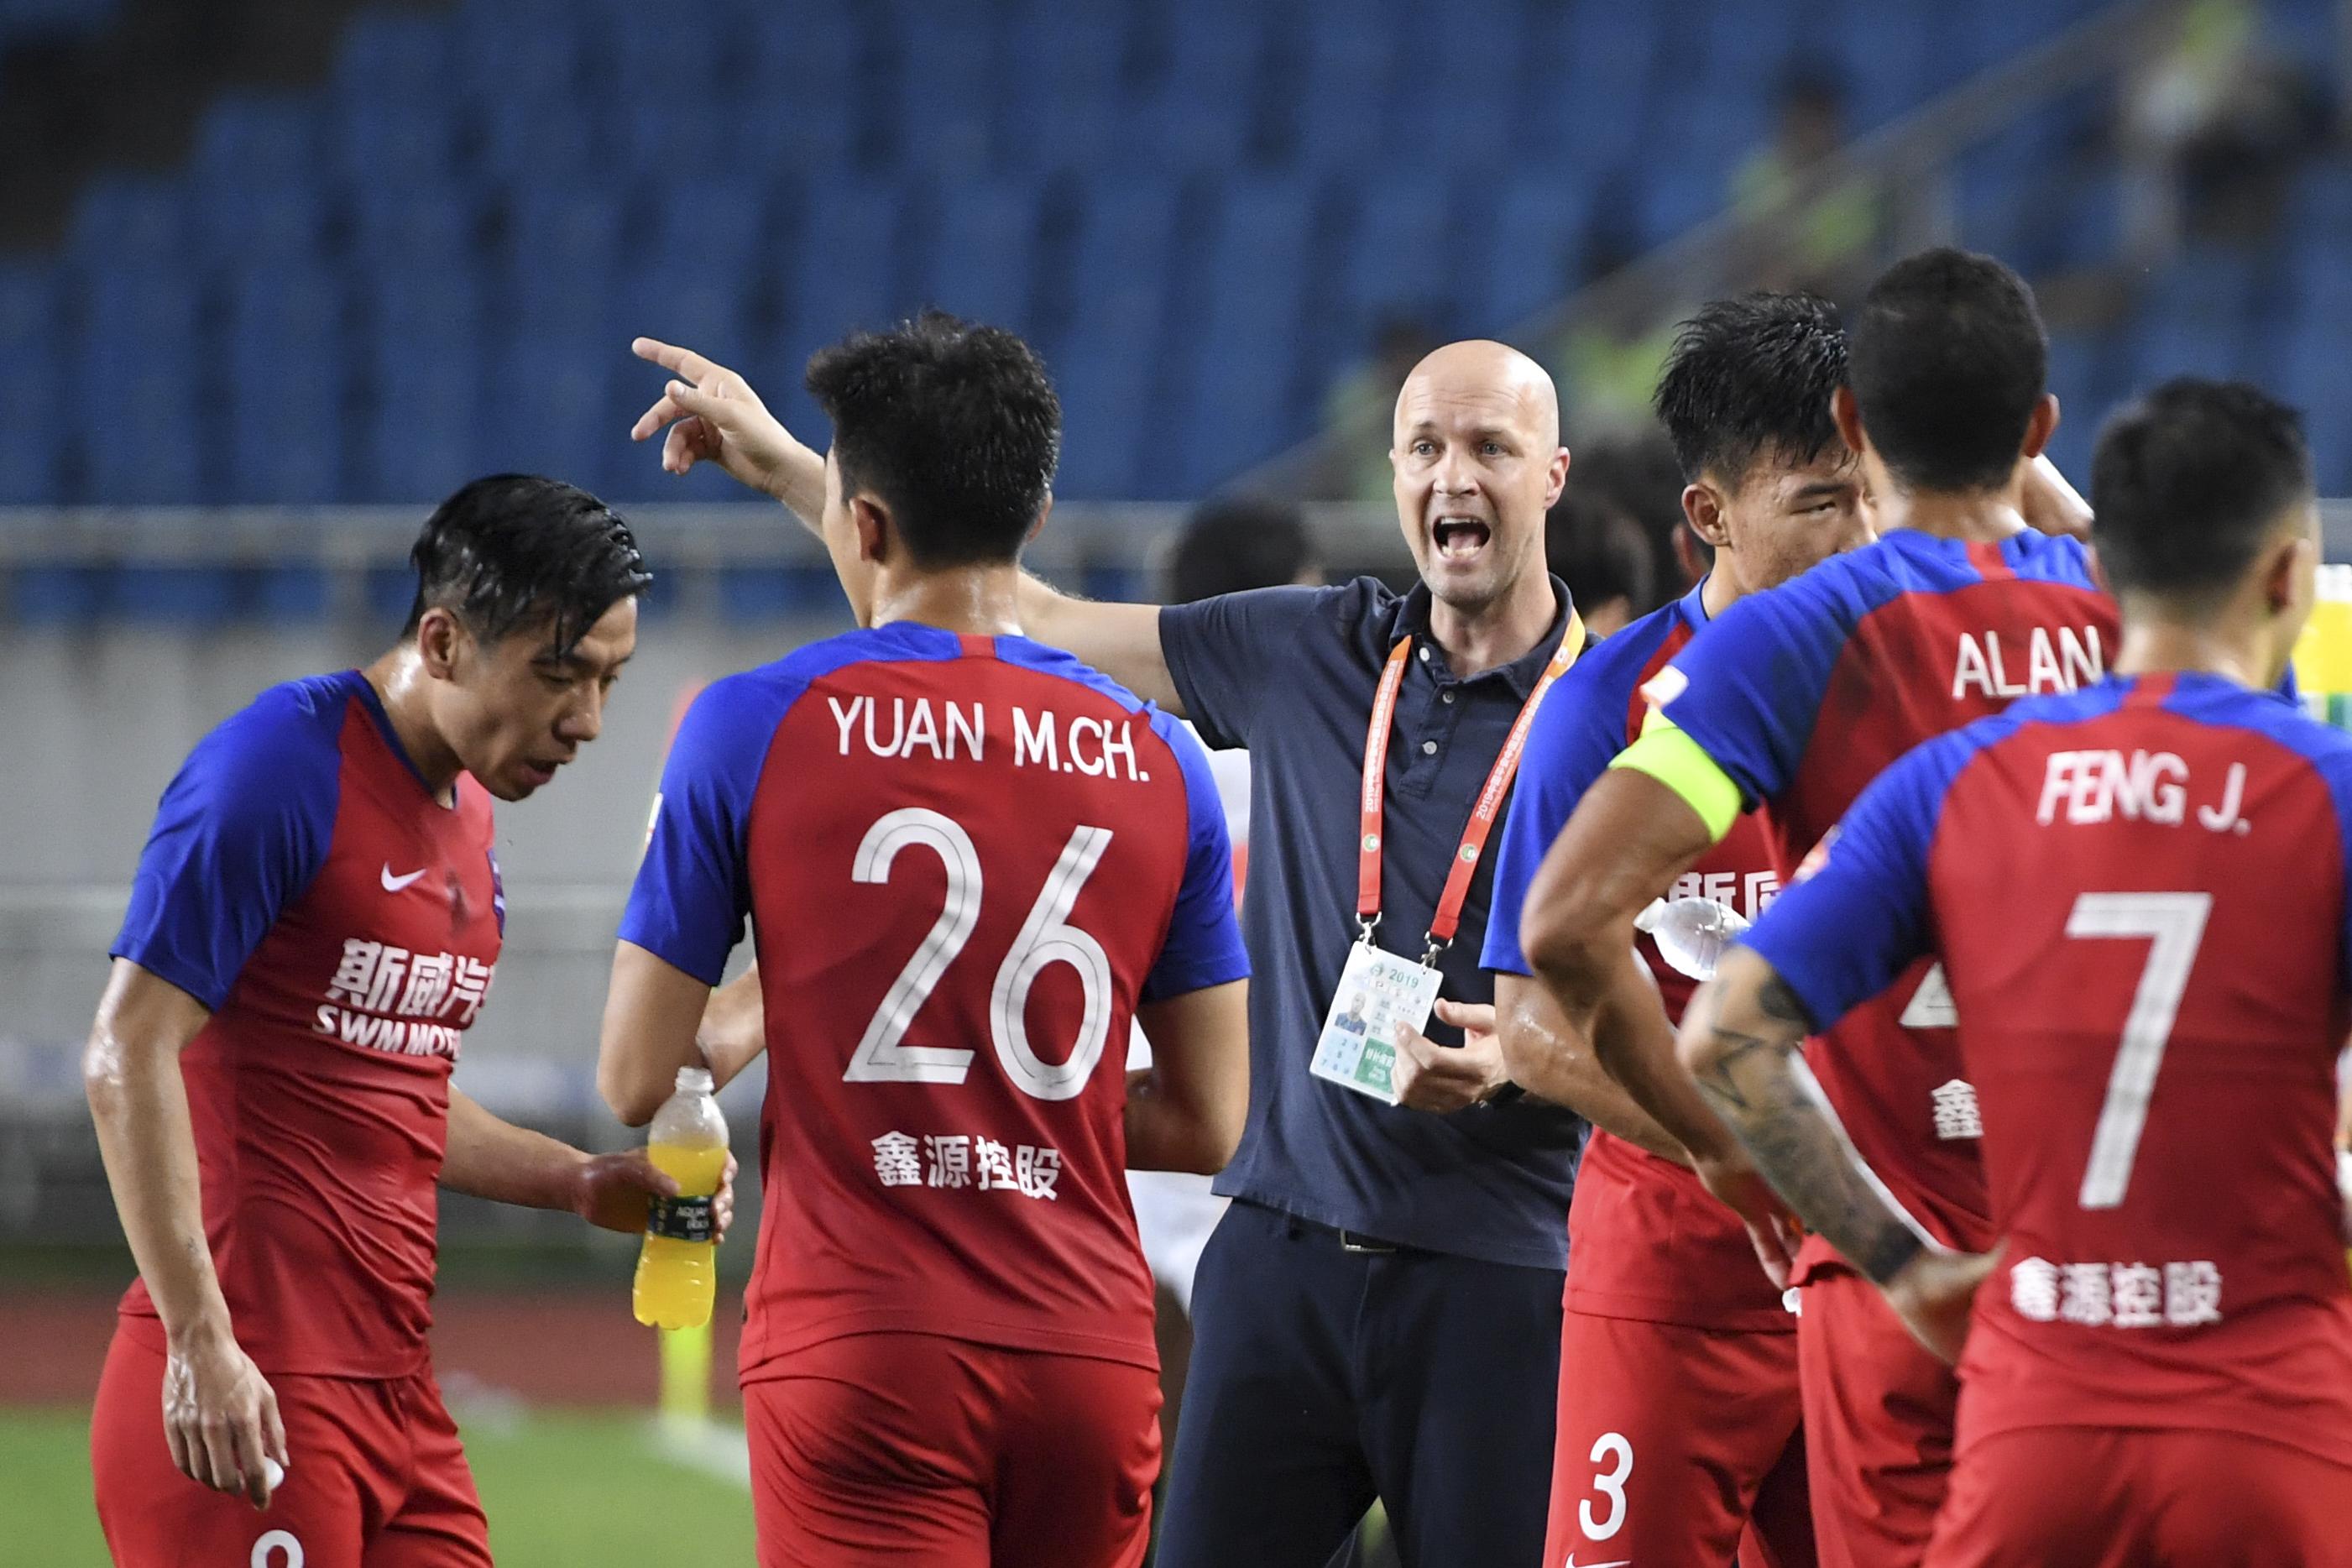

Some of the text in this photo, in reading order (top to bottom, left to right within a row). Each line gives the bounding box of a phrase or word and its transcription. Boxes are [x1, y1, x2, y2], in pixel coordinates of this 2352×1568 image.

[1951, 625, 2105, 700] ALAN
[828, 696, 1151, 782] YUAN M.CH.
[2036, 749, 2251, 836] FENG J.
[325, 938, 495, 1023] 斯威汽
[842, 807, 1115, 1101] 26
[1388, 968, 1419, 990] 2019
[311, 1004, 406, 1053] SWM
[2064, 891, 2213, 1210] 7
[871, 1131, 1061, 1200] 鑫源控股
[1578, 1432, 1633, 1541] 3
